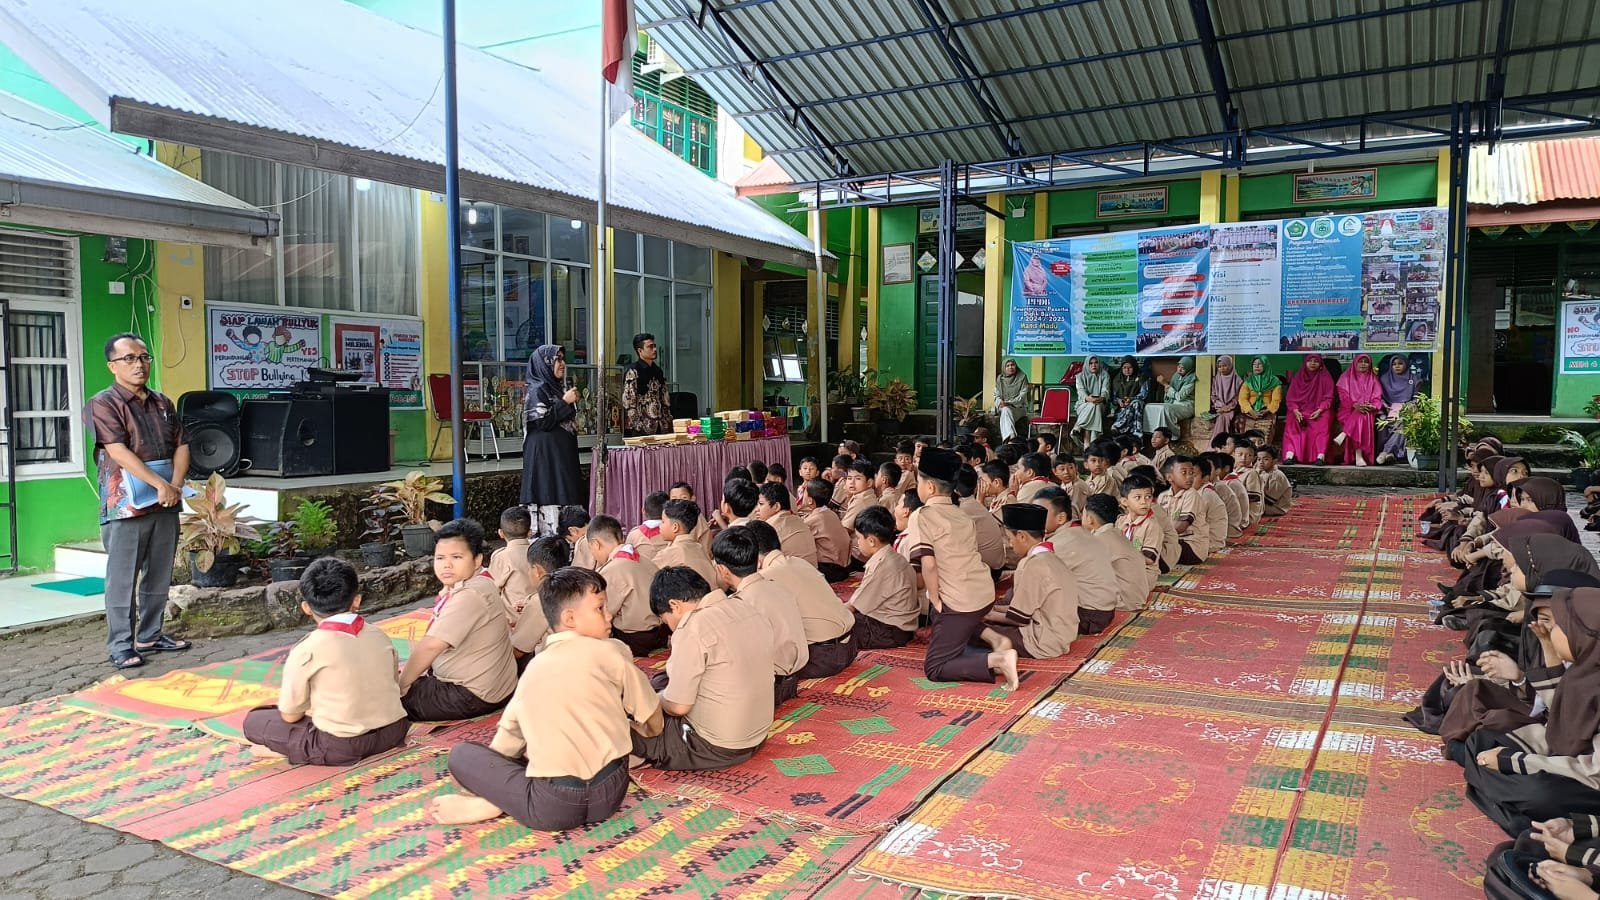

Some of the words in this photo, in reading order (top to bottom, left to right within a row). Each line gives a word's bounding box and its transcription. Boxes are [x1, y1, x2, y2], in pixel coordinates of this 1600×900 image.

[1211, 270, 1226, 278] Visi
[1210, 295, 1227, 303] Misi
[214, 343, 229, 353] NO
[301, 347, 318, 356] YES
[1576, 343, 1600, 353] STO
[226, 367, 260, 381] STOP
